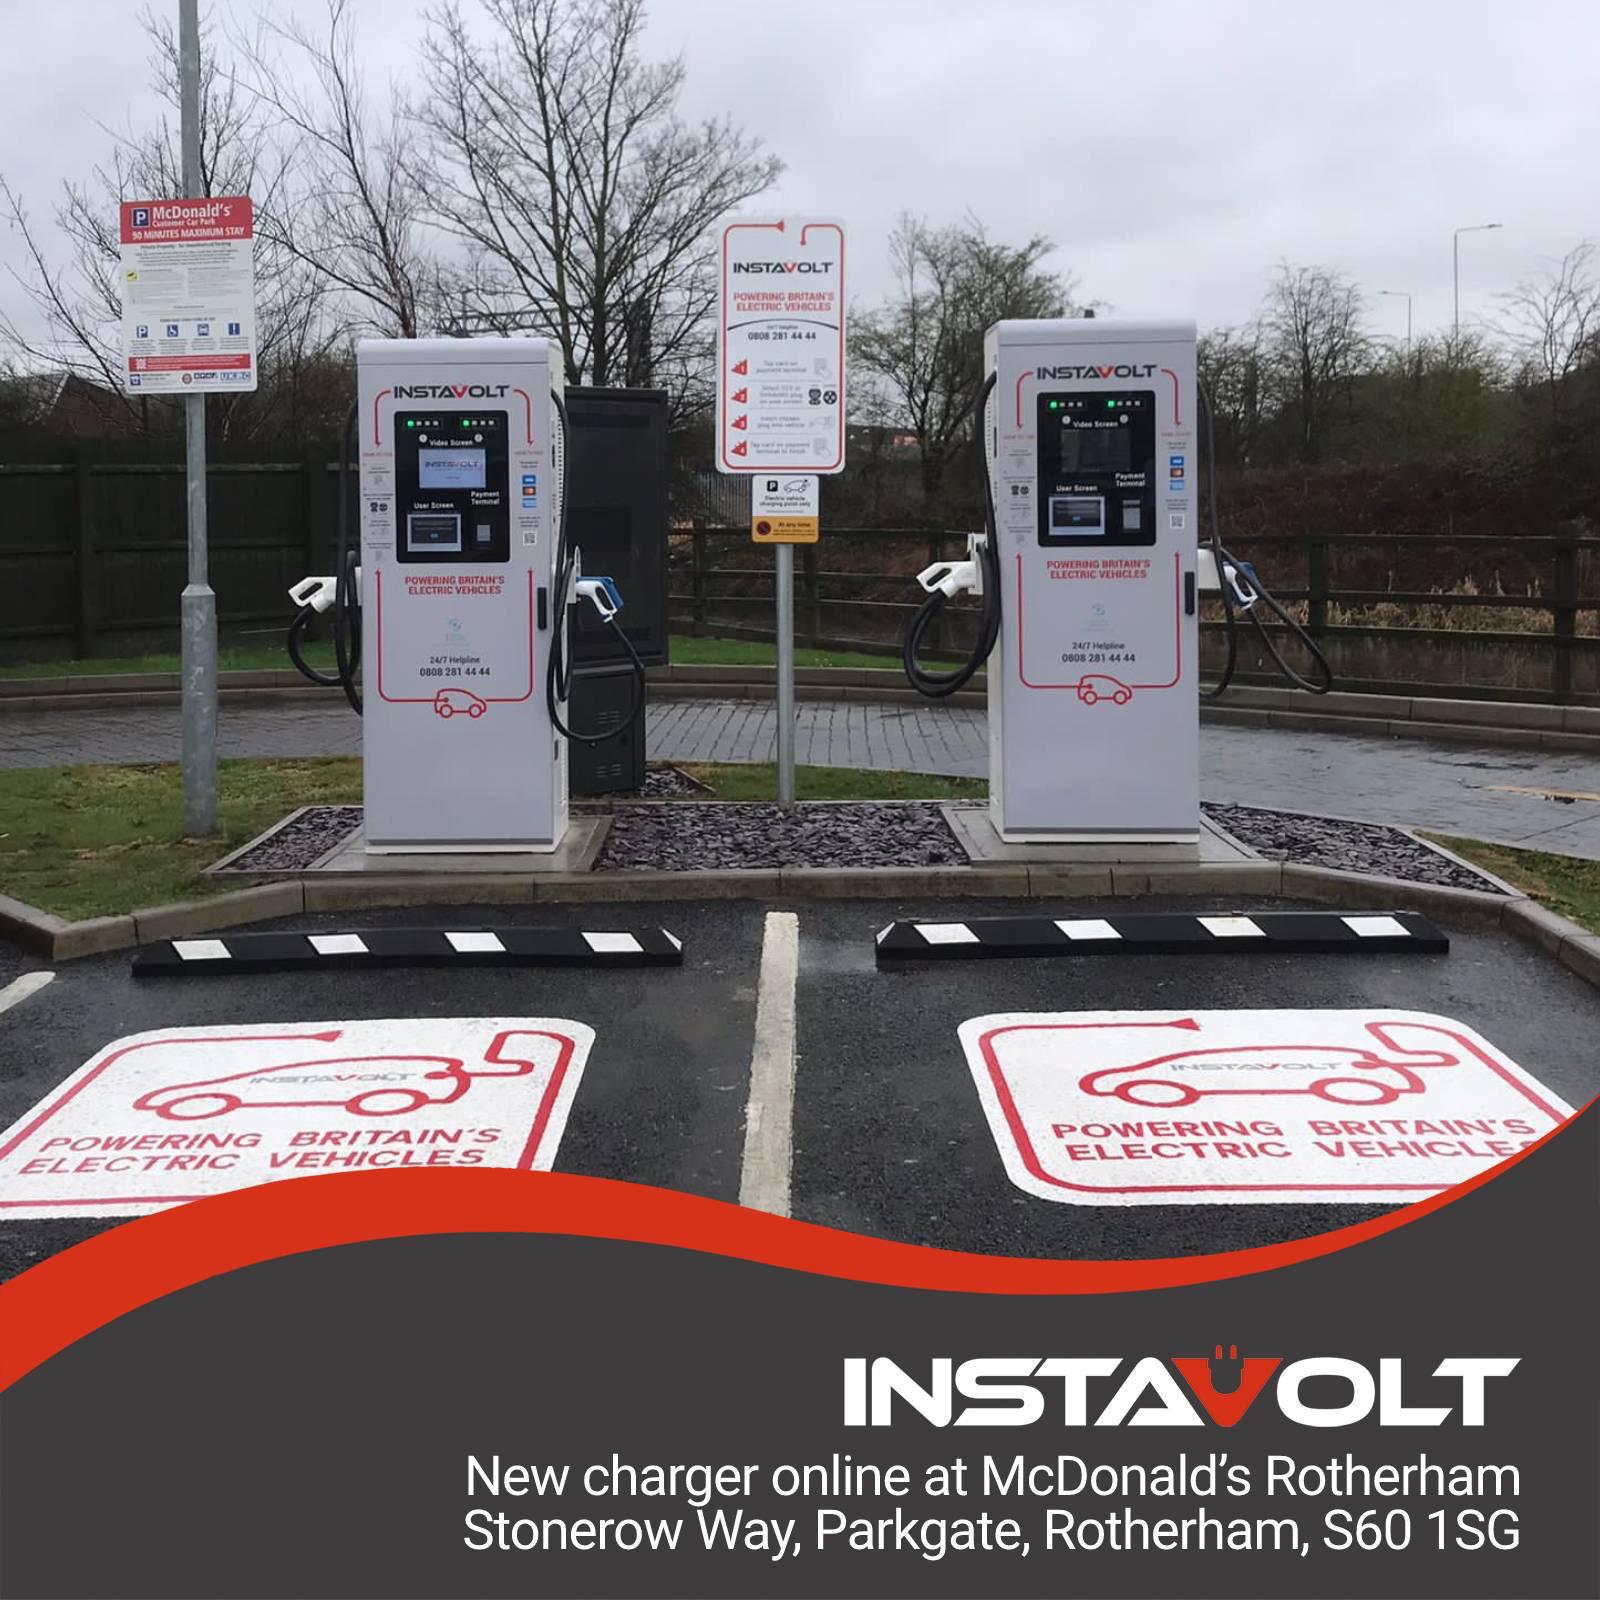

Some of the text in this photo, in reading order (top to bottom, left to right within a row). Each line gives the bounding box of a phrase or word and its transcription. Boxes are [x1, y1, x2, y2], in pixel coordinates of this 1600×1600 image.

[153, 203, 231, 219] McDonald's
[152, 218, 216, 228] Customer Car Park
[144, 230, 179, 239] MINUTES
[181, 228, 224, 238] MAXIMUM
[225, 227, 245, 236] STAY
[733, 262, 833, 274] INSTAVOLT
[733, 291, 834, 301] POWERING BRITAIN'S
[736, 303, 831, 311] ELECTRIC VEHICLES
[747, 332, 816, 340] 0808 281 44 44
[1037, 364, 1158, 380] INSTAVOLT
[394, 385, 510, 399] INSTAVOLT
[1115, 472, 1146, 481] Payment
[1074, 484, 1098, 492] Screen
[471, 491, 500, 499] Payment
[1047, 560, 1151, 569] POWERING BRITAIN'S
[1050, 569, 1147, 579] ELECTRIC VEHICLES
[405, 575, 504, 585] POWERING BRITAIN'S
[408, 585, 502, 595] ELECTRIC VEHICLES
[1072, 642, 1125, 651] 24/7 Helpline
[430, 656, 480, 665] 24/7 Helpline
[1062, 653, 1136, 663] 0808 281 44 44
[419, 667, 491, 677] 0808 281 44 44
[1169, 1063, 1341, 1071] INSTAVOLT
[249, 1072, 417, 1084] INSTAVOLT
[1051, 1119, 1536, 1140] POWERING BRITAIN'S
[38, 1128, 502, 1153] POWERING BRITAIN'S
[1064, 1142, 1292, 1161] ELECTRIC
[18, 1149, 486, 1176] ELECTRIC VEHICLES
